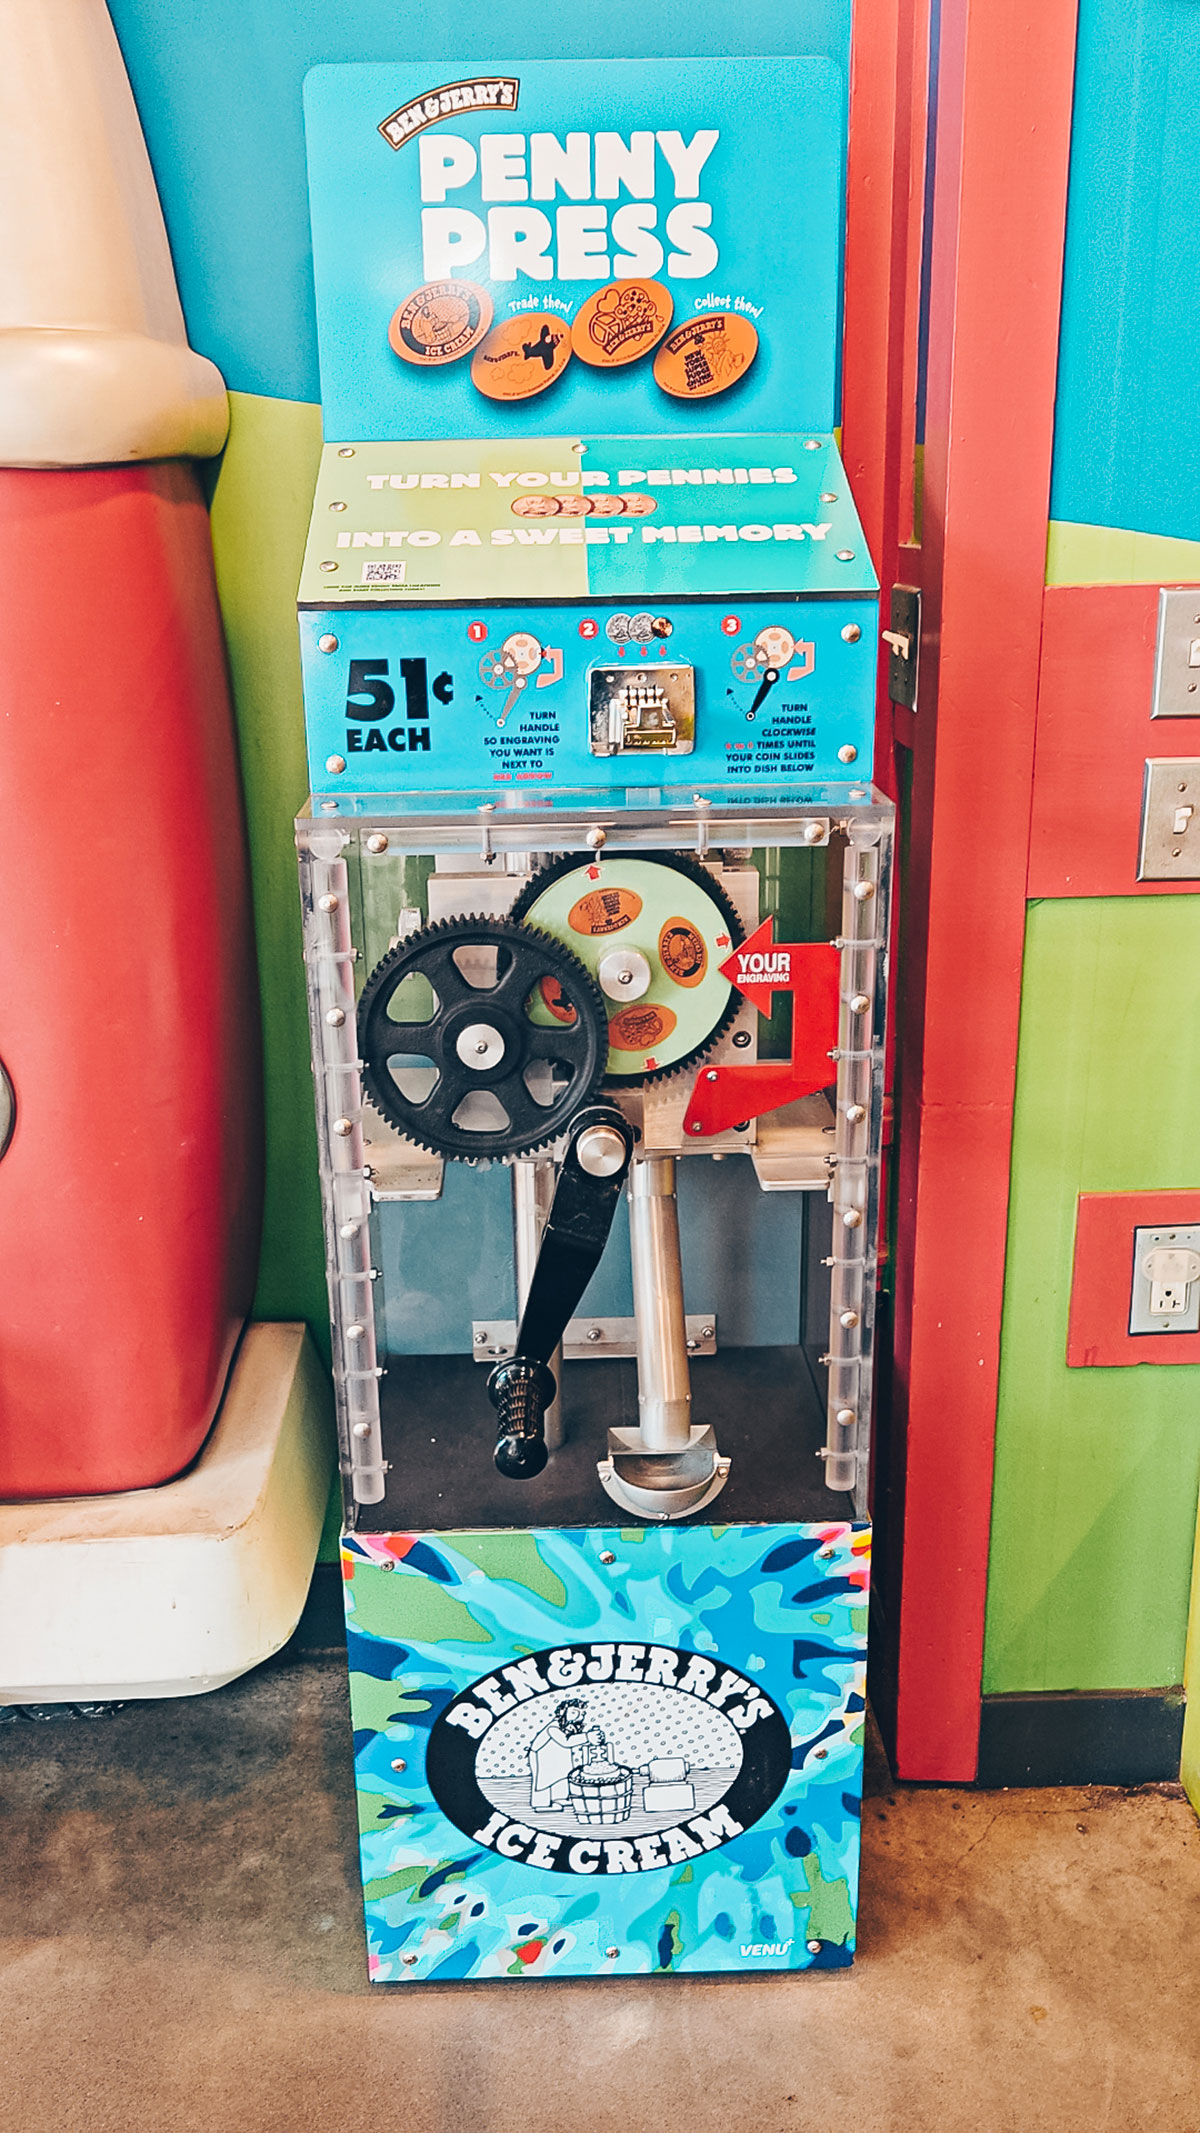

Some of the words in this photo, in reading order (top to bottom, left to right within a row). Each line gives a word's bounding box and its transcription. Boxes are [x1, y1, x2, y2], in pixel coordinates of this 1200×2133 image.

[384, 80, 515, 144] BEN&JERRY'S
[418, 130, 719, 202] PENNY
[421, 202, 719, 281] PRESS
[508, 293, 539, 313] Trade
[694, 291, 731, 310] Collect
[424, 344, 442, 357] ICE
[444, 326, 475, 354] CREAM
[367, 473, 481, 490] TURN
[489, 471, 610, 488] YOUR
[617, 468, 798, 487] PENNIES
[336, 530, 441, 548] INTO
[450, 529, 482, 546] A
[490, 527, 634, 546] SWEET
[641, 523, 833, 544] MEMORY
[473, 625, 481, 639] 1
[583, 622, 594, 636] 2
[726, 619, 738, 632] 3
[345, 657, 454, 722] 51¢
[781, 703, 808, 713] TURN
[529, 711, 557, 720] TURN
[772, 715, 812, 725] HANDLE
[519, 723, 560, 732] HANDLE
[761, 727, 817, 737] CLOCKWISE
[346, 726, 432, 753] EACH
[484, 736, 498, 746] SO
[500, 735, 561, 745] ENGRAVING
[757, 740, 785, 750] TIMES
[787, 739, 816, 749] UNTIL
[490, 748, 511, 758] YOU
[513, 748, 543, 757] WANT
[545, 747, 555, 756] IS
[726, 753, 753, 762] YOUR
[755, 752, 780, 761] COIN
[783, 751, 816, 761] SLIDES
[501, 760, 527, 769] NEXT
[530, 759, 543, 769] TO
[727, 765, 752, 774] INTO
[754, 764, 778, 773] DISH
[780, 763, 815, 772] BELOW
[737, 952, 791, 973] YOUR
[737, 972, 790, 984] ENGRAVING
[445, 1644, 775, 1739] BEN&JERRY'S
[472, 1811, 563, 1870] ICE
[568, 1803, 744, 1875] CREAM
